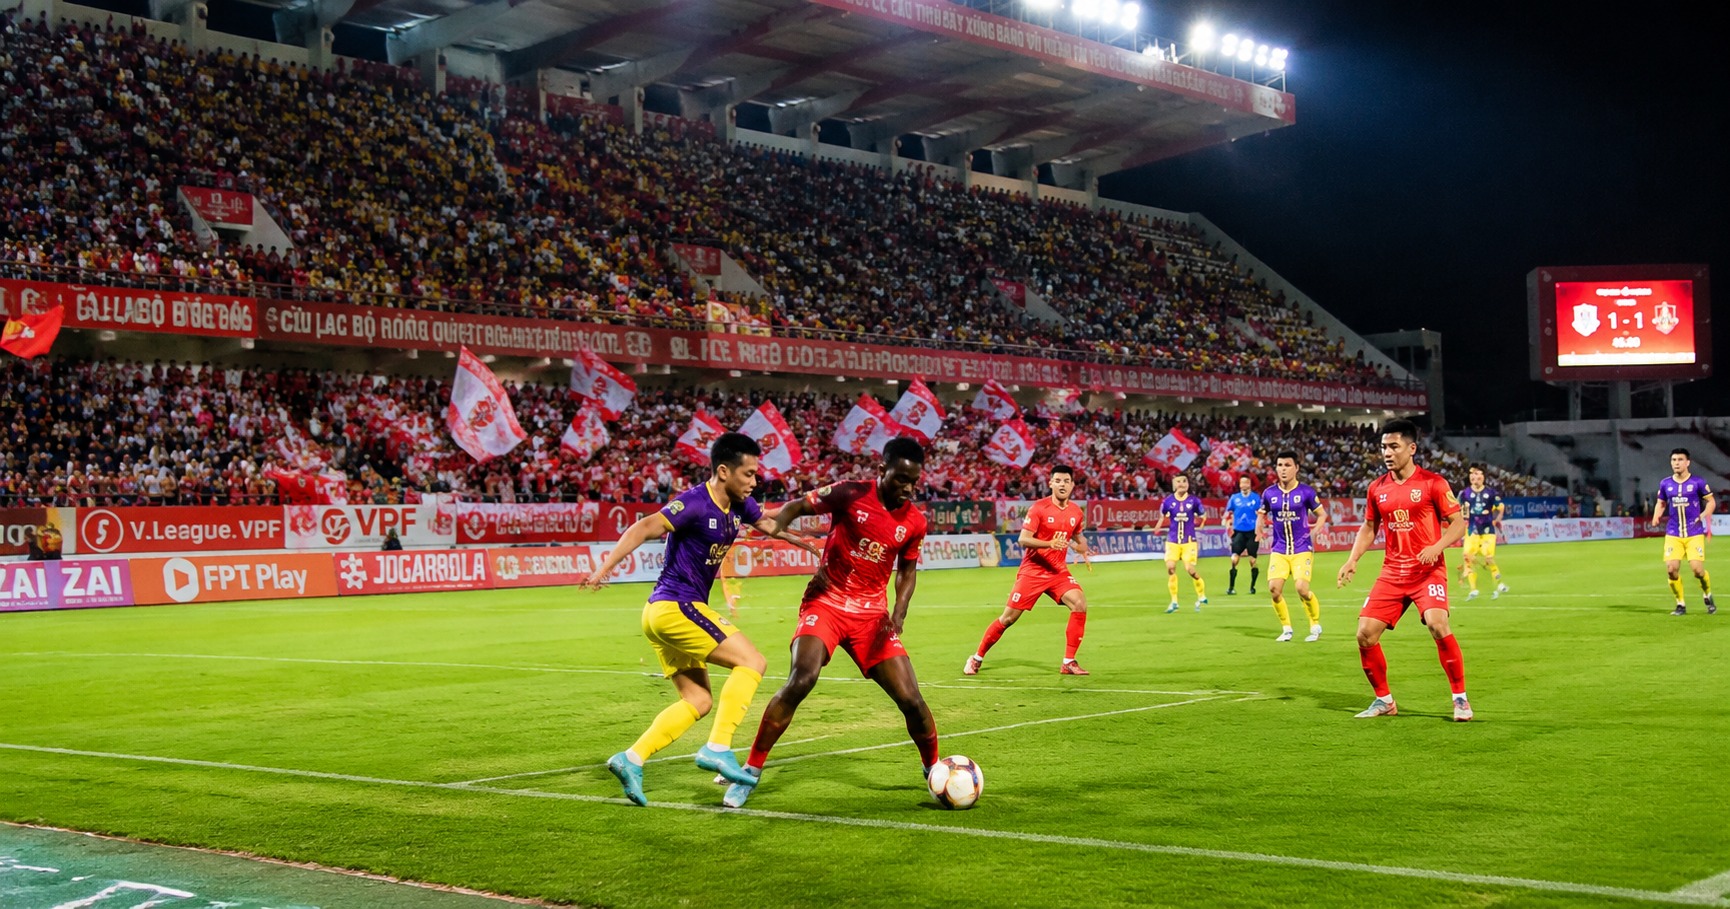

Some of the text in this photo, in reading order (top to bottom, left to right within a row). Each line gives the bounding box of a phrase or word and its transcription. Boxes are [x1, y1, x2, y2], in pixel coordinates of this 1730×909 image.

[1607, 312, 1617, 329] 1
[1634, 312, 1643, 329] 1
[355, 508, 416, 536] VPF
[203, 563, 307, 594] FPT Play
[1427, 583, 1446, 597] 88
